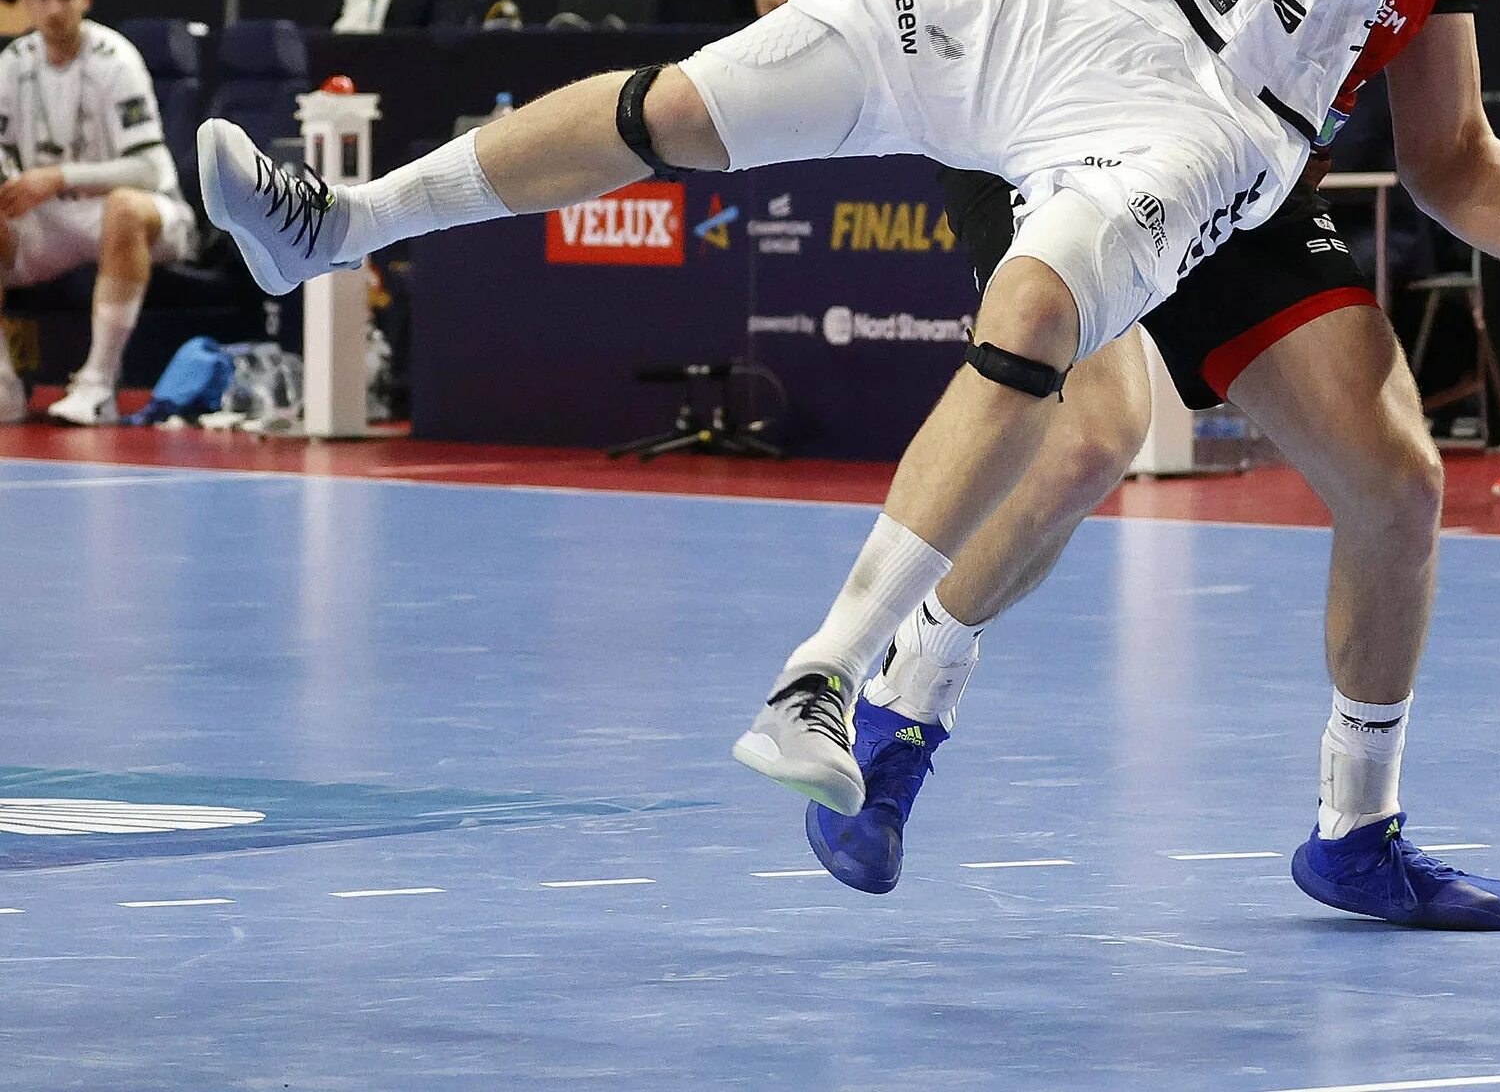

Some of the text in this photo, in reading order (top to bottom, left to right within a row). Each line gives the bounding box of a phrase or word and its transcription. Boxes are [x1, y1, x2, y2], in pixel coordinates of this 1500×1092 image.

[559, 198, 673, 248] VELUX
[1148, 222, 1166, 258] KIEL
[894, 728, 926, 748] adidas
